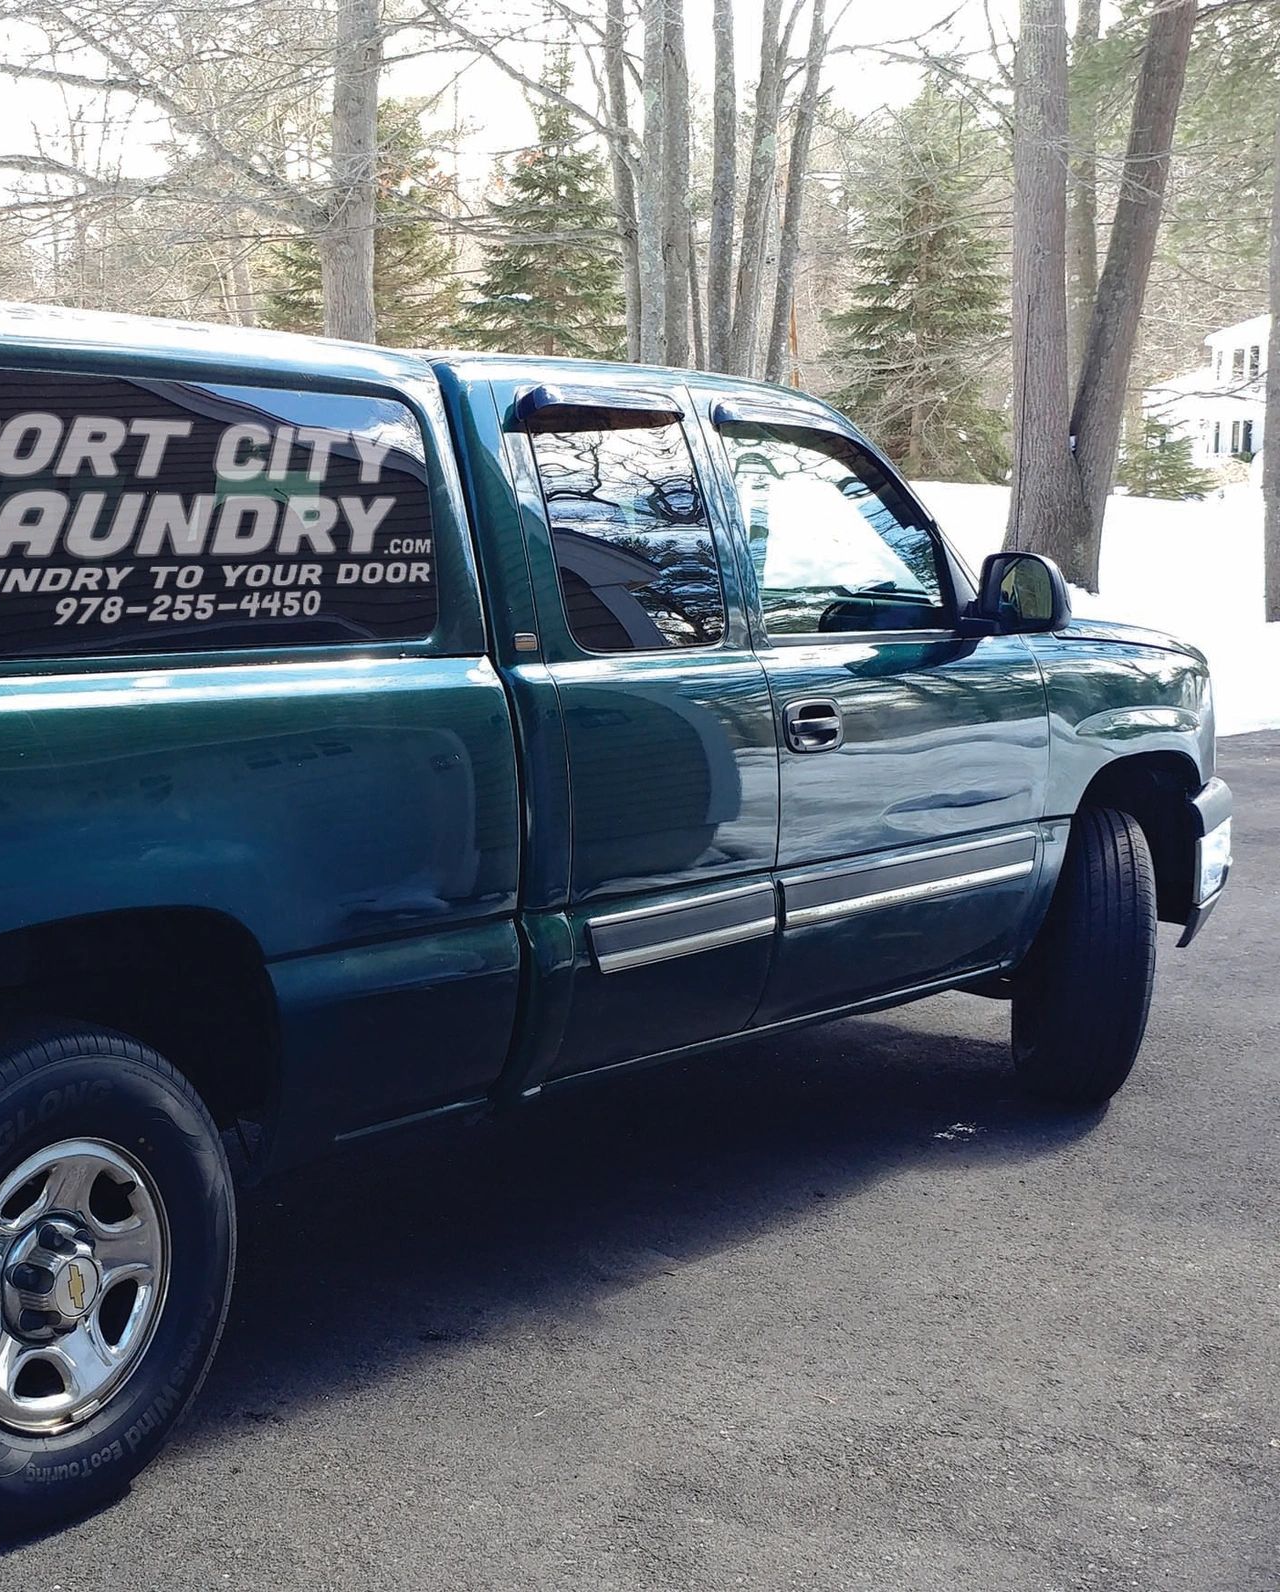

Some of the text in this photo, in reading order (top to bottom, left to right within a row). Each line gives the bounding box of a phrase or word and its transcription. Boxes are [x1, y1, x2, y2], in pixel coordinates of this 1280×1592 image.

[214, 421, 393, 484] CITY
[383, 538, 432, 555] .COM
[149, 565, 203, 589] TO
[223, 563, 322, 588] YOUR
[336, 562, 431, 584] DOOR
[54, 591, 322, 626] 978-255-4450
